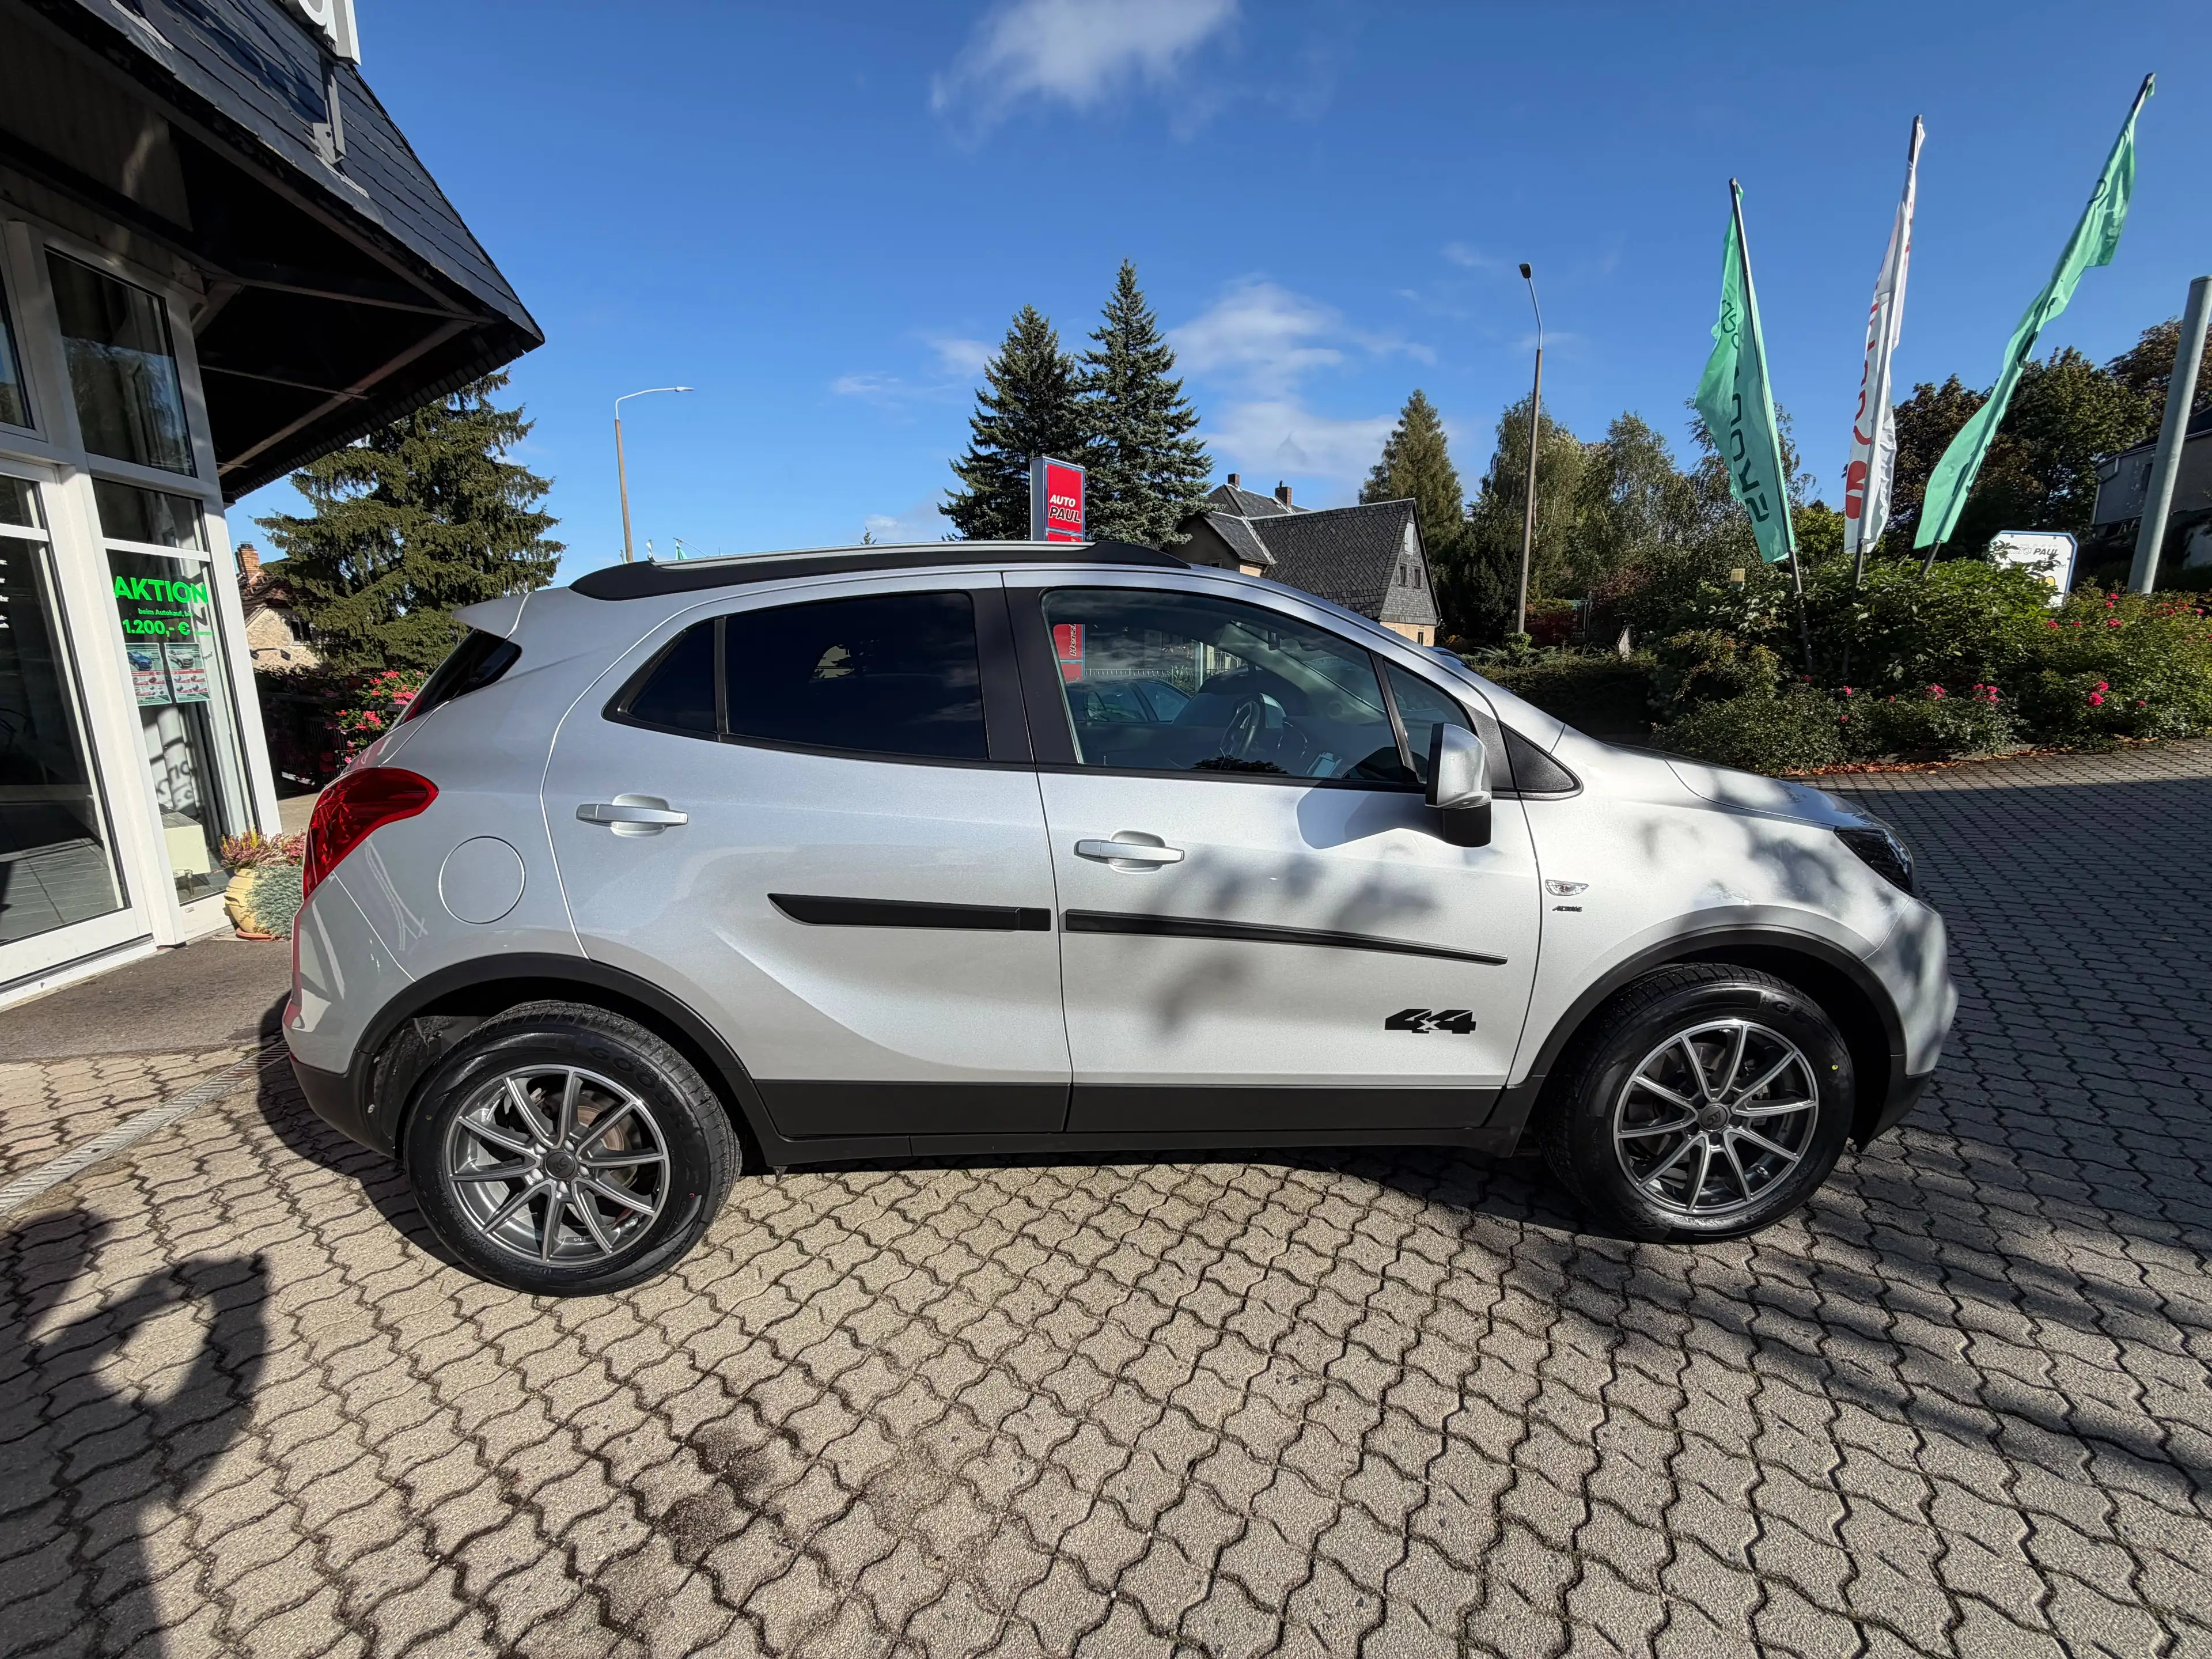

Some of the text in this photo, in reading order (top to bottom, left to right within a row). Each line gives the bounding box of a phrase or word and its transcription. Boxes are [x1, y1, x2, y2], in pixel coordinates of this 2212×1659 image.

[1050, 494, 1075, 507] AUTO
[1048, 505, 1081, 524] PAUL
[113, 576, 208, 604] AKTION
[122, 619, 191, 637] 1.200,- €
